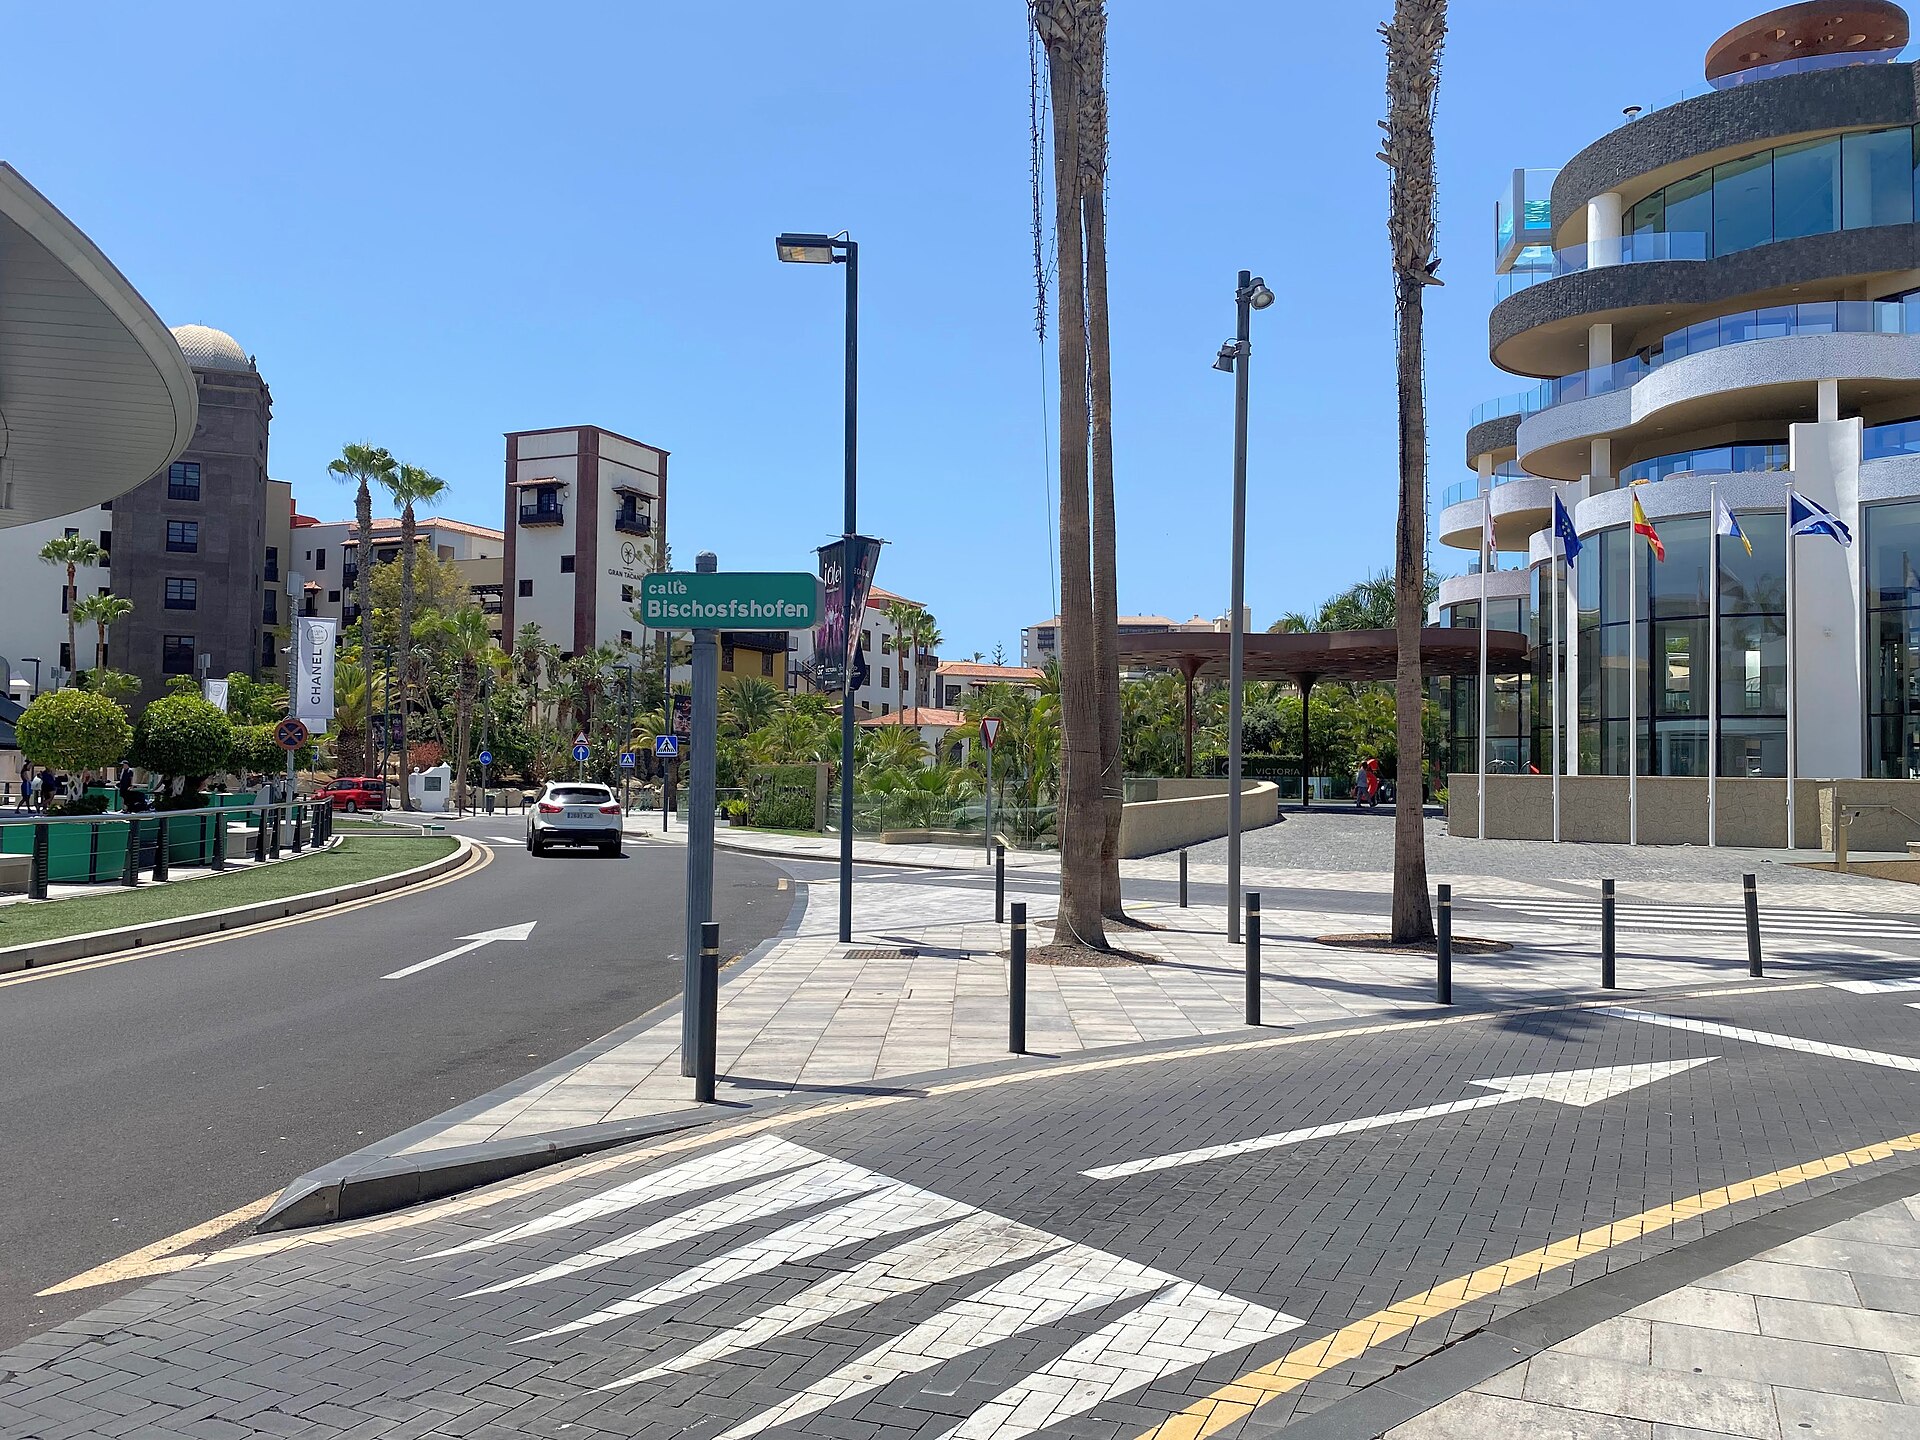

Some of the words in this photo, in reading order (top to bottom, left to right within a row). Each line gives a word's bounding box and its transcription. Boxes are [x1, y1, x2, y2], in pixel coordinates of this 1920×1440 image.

[608, 568, 623, 577] GRAN
[647, 599, 809, 618] Bischosfshofen
[310, 648, 322, 705] CHANEL
[1255, 767, 1301, 776] VICTORIA
